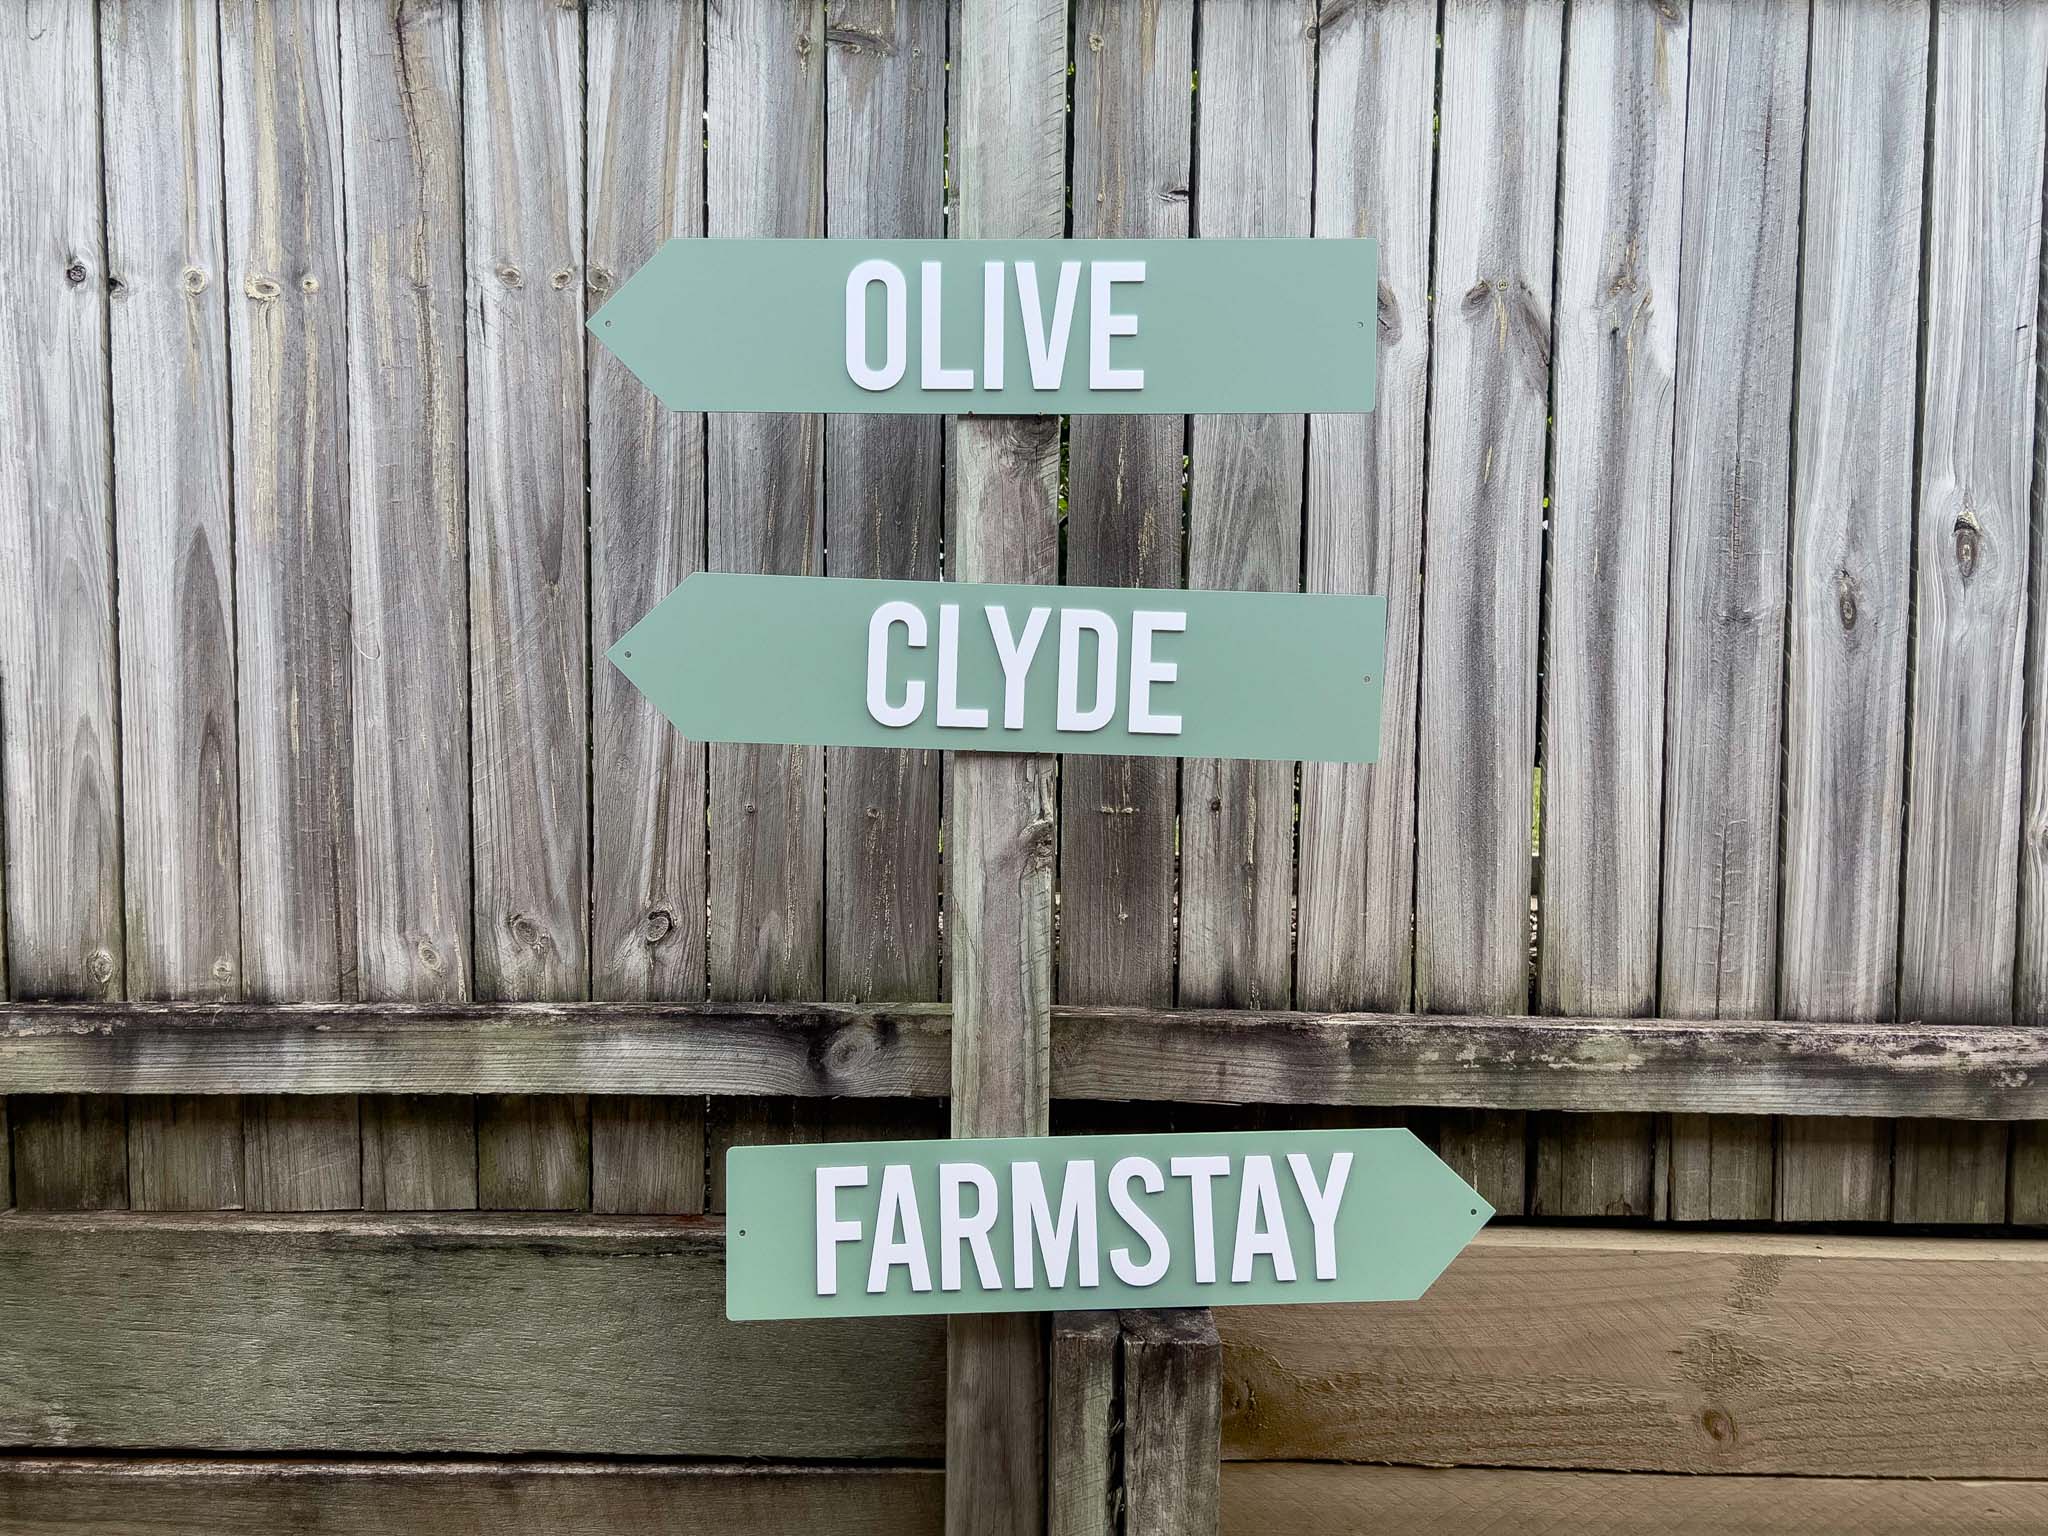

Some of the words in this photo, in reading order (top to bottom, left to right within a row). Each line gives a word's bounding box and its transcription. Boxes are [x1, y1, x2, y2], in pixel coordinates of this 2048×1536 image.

[845, 259, 1146, 391] OLIVE
[866, 601, 1187, 735] CLYDE
[815, 1152, 1354, 1295] FARMSTAY
